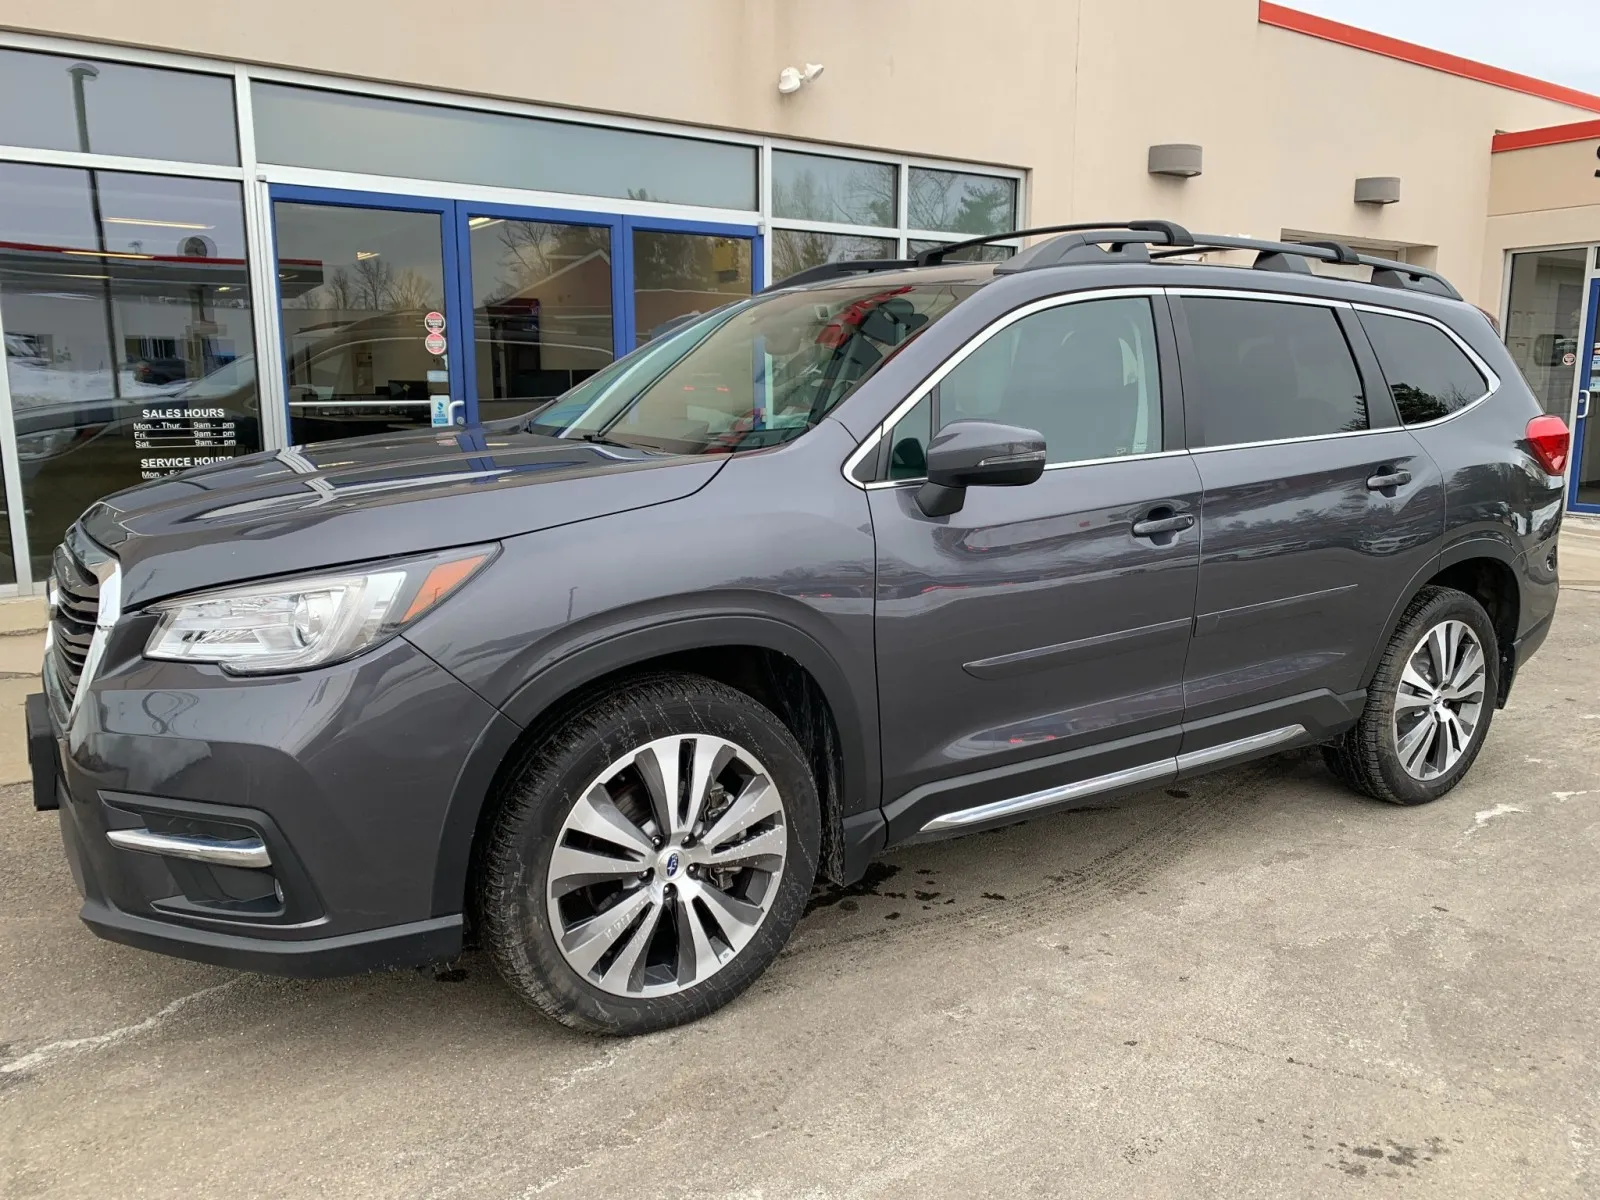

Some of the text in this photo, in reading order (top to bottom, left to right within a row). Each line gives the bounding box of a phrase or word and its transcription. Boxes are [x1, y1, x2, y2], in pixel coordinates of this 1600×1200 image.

[142, 408, 225, 418] SALES HOURS
[133, 422, 154, 430] Mon.
[161, 421, 182, 429] Thur.
[193, 421, 211, 429] 9am
[222, 421, 235, 429] pm
[193, 430, 211, 438] 9am
[222, 430, 235, 438] pm
[135, 440, 151, 448] Sat.
[195, 439, 212, 447] 9am
[223, 439, 236, 447] pm
[140, 457, 191, 467] SERVICE
[141, 470, 162, 479] Mon.
